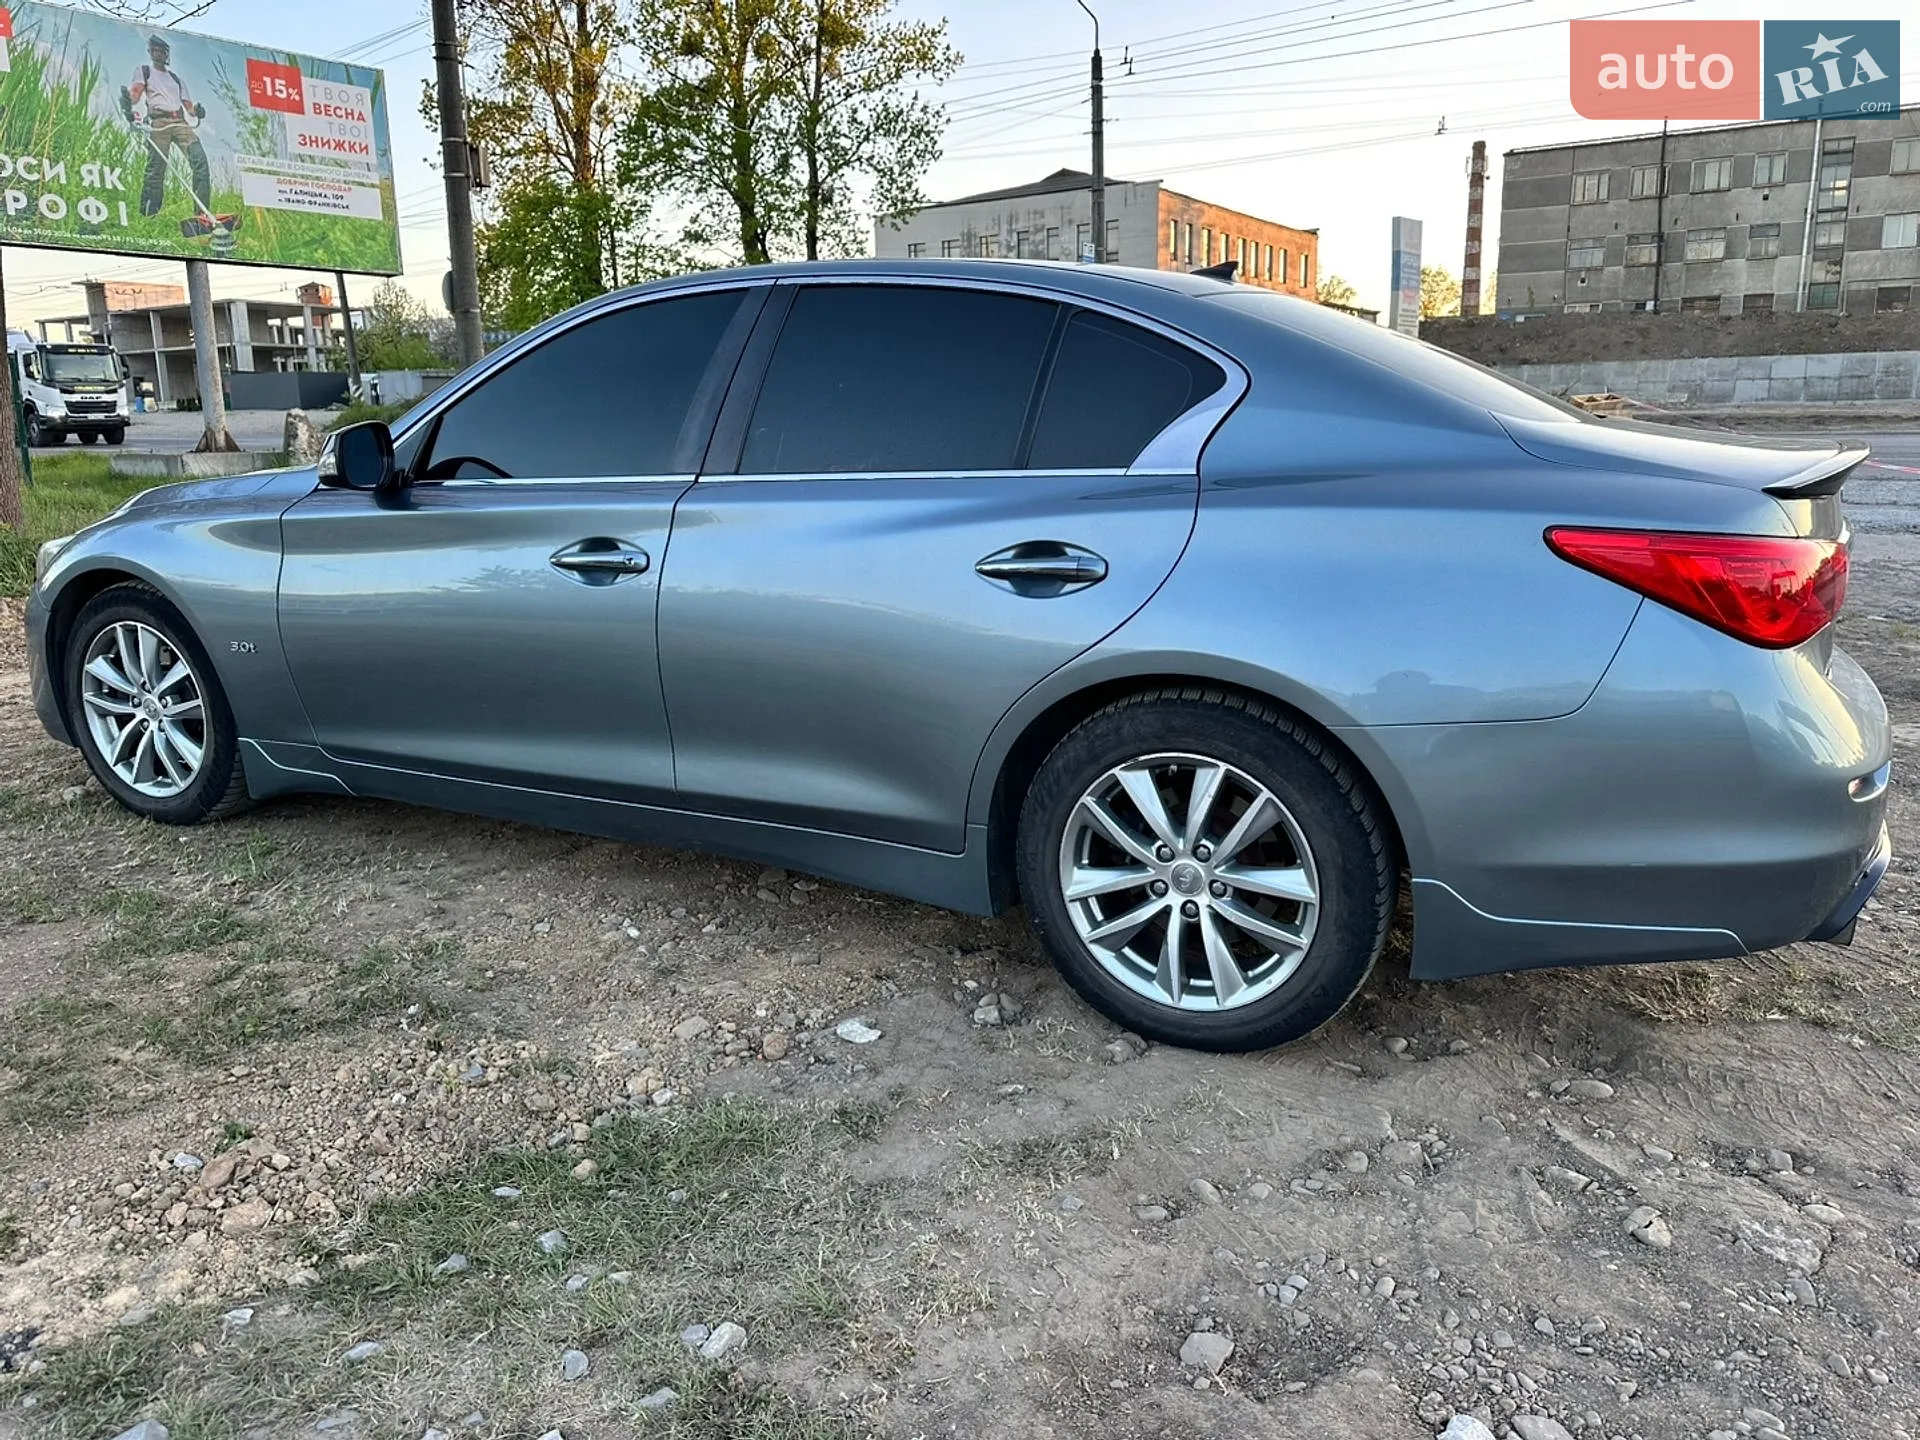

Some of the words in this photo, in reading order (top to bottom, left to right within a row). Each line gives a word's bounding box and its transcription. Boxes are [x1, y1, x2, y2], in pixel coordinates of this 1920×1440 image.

[309, 85, 364, 106] ТВОЯ
[312, 102, 366, 122] ВЕСНА
[298, 134, 369, 155] ЗНИЖКИ
[80, 163, 125, 191] ЯК
[5, 189, 128, 226] РОФІ
